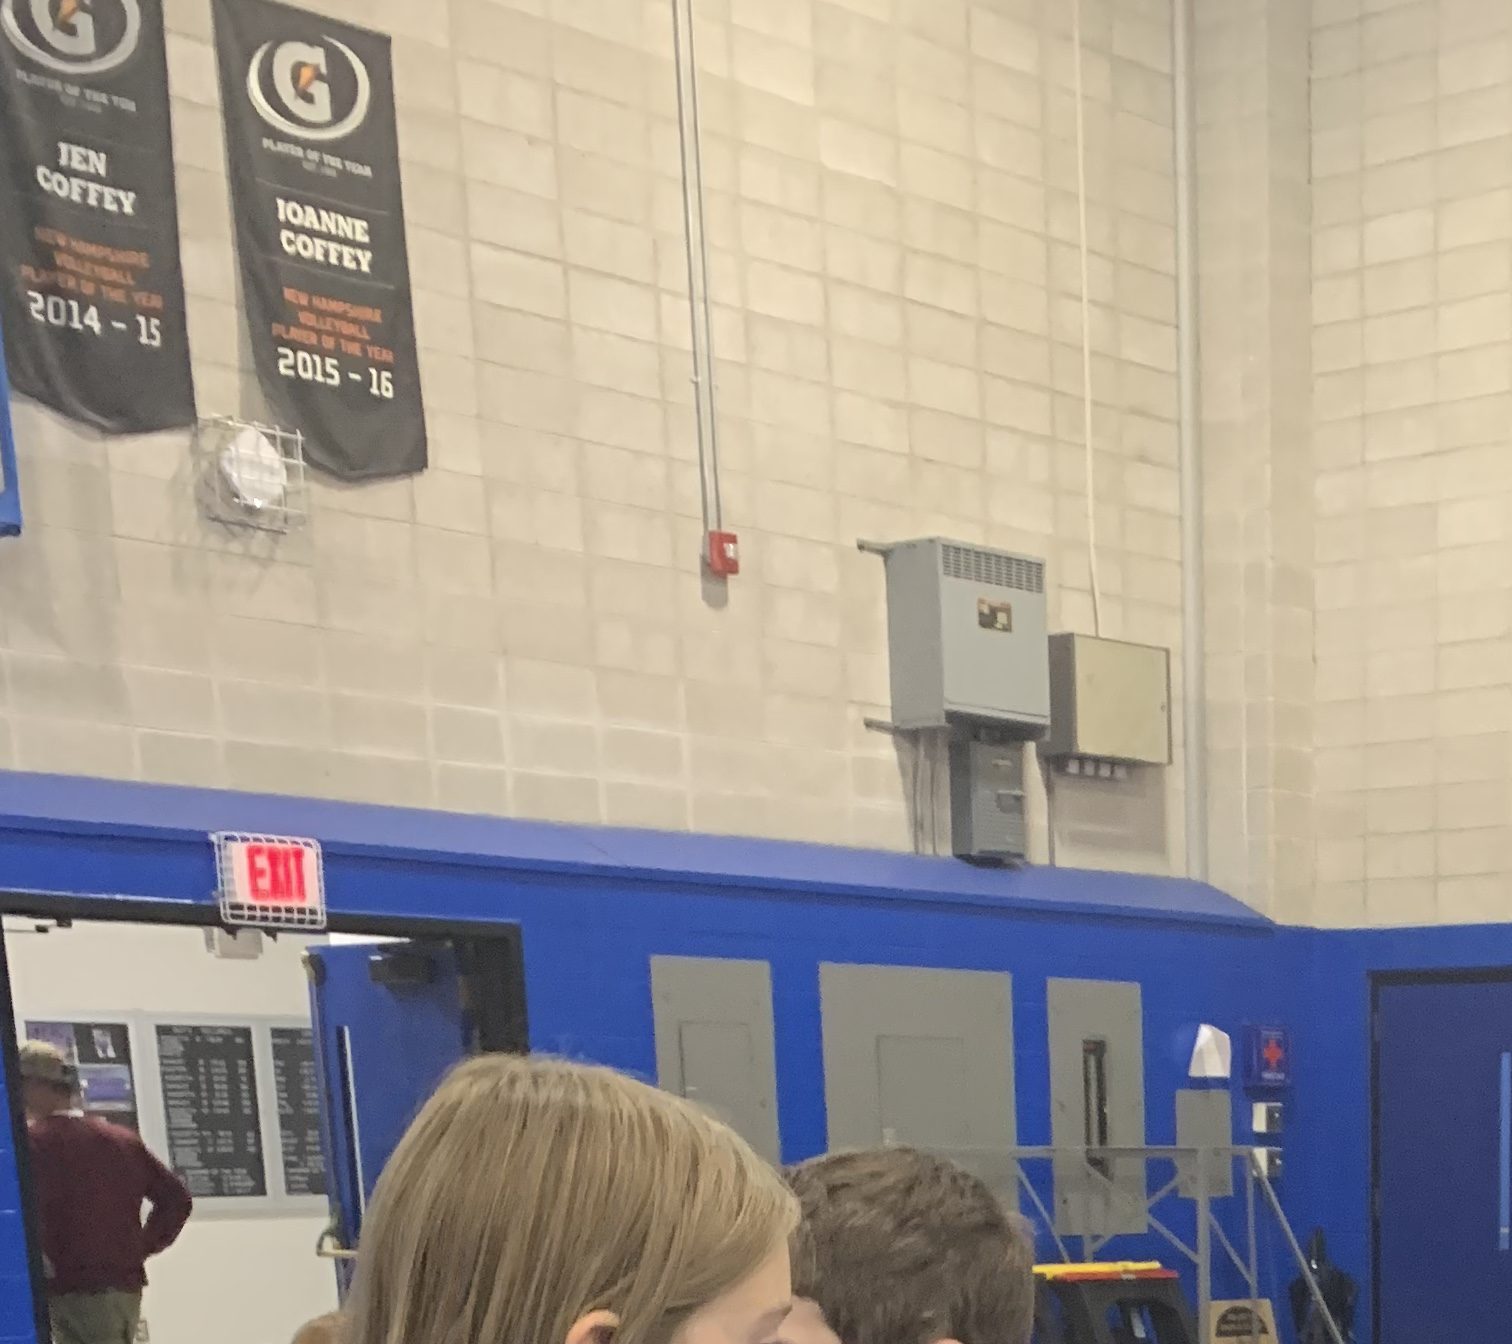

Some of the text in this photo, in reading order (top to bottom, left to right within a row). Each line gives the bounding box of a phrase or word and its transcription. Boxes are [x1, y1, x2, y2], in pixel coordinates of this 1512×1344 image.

[57, 141, 107, 178] JEN
[36, 164, 136, 216] COFFEY
[276, 197, 370, 243] JOANNE
[279, 229, 373, 273] COFFEY
[27, 289, 101, 335] 2014
[135, 313, 161, 348] 15
[277, 346, 340, 386] 2015
[368, 366, 394, 399] 16
[247, 844, 306, 902] EXIT
